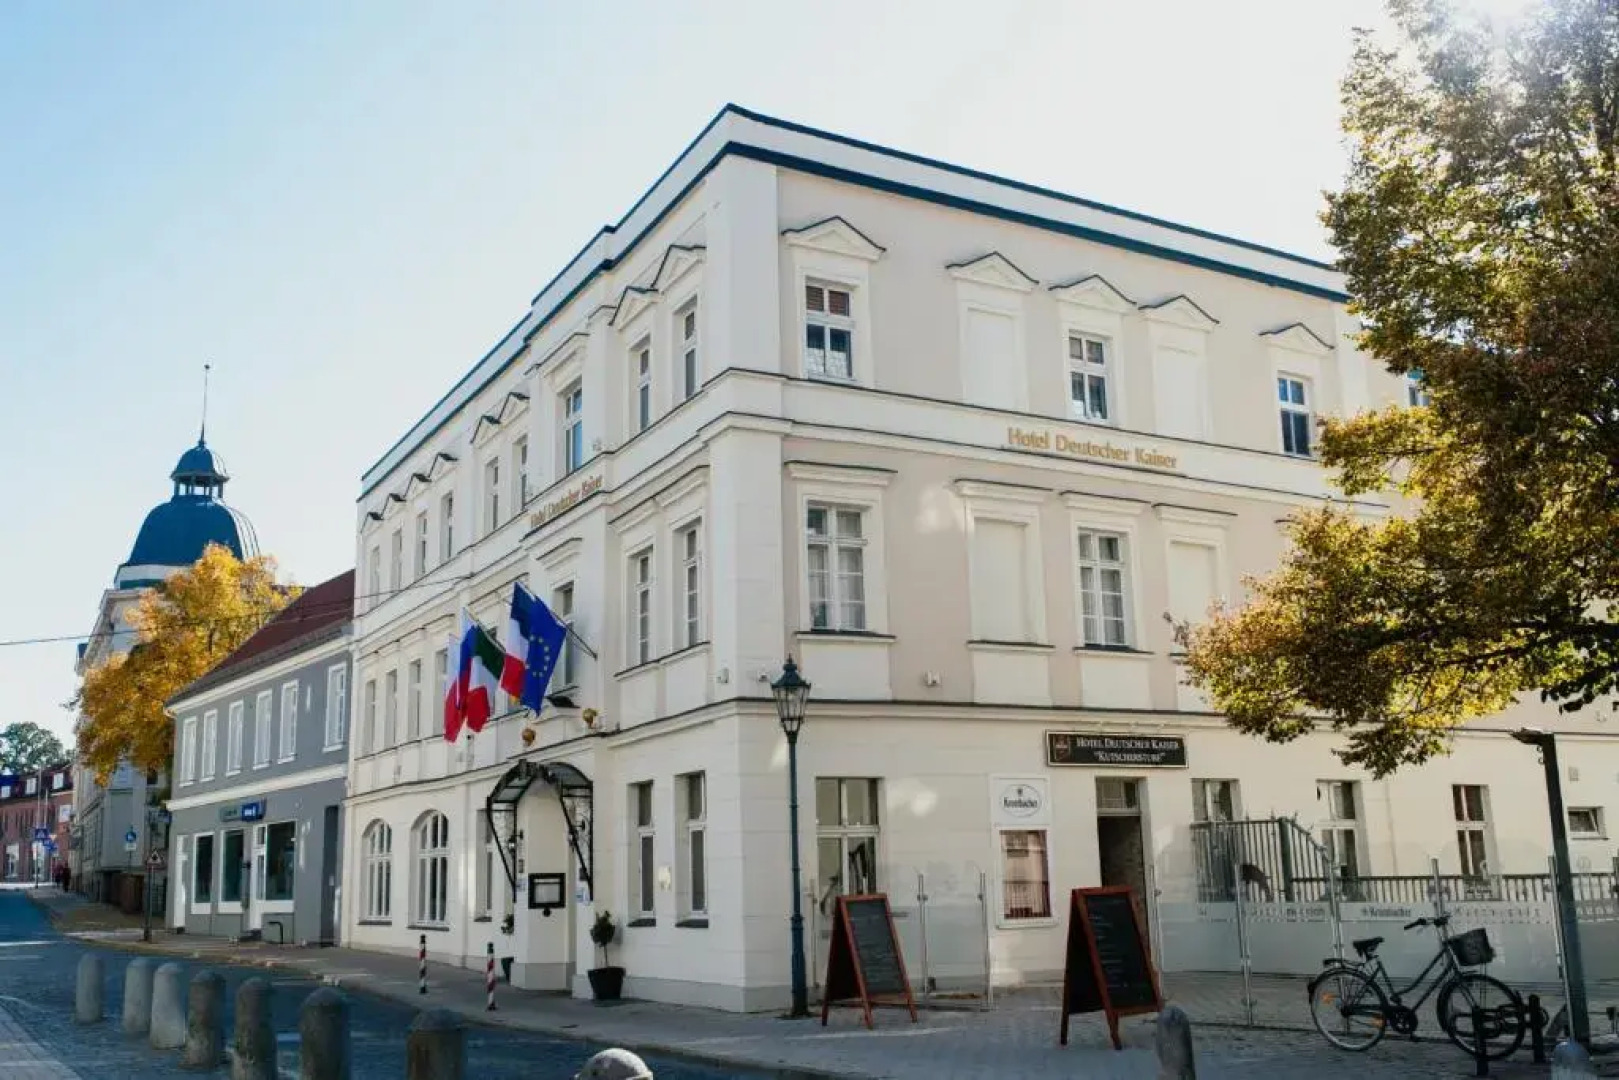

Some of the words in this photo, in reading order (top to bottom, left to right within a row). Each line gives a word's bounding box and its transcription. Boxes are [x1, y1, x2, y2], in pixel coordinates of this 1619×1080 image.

[1007, 427, 1049, 449] Hotel
[1055, 434, 1129, 461] Deutscher
[1135, 447, 1177, 468] Kaiser
